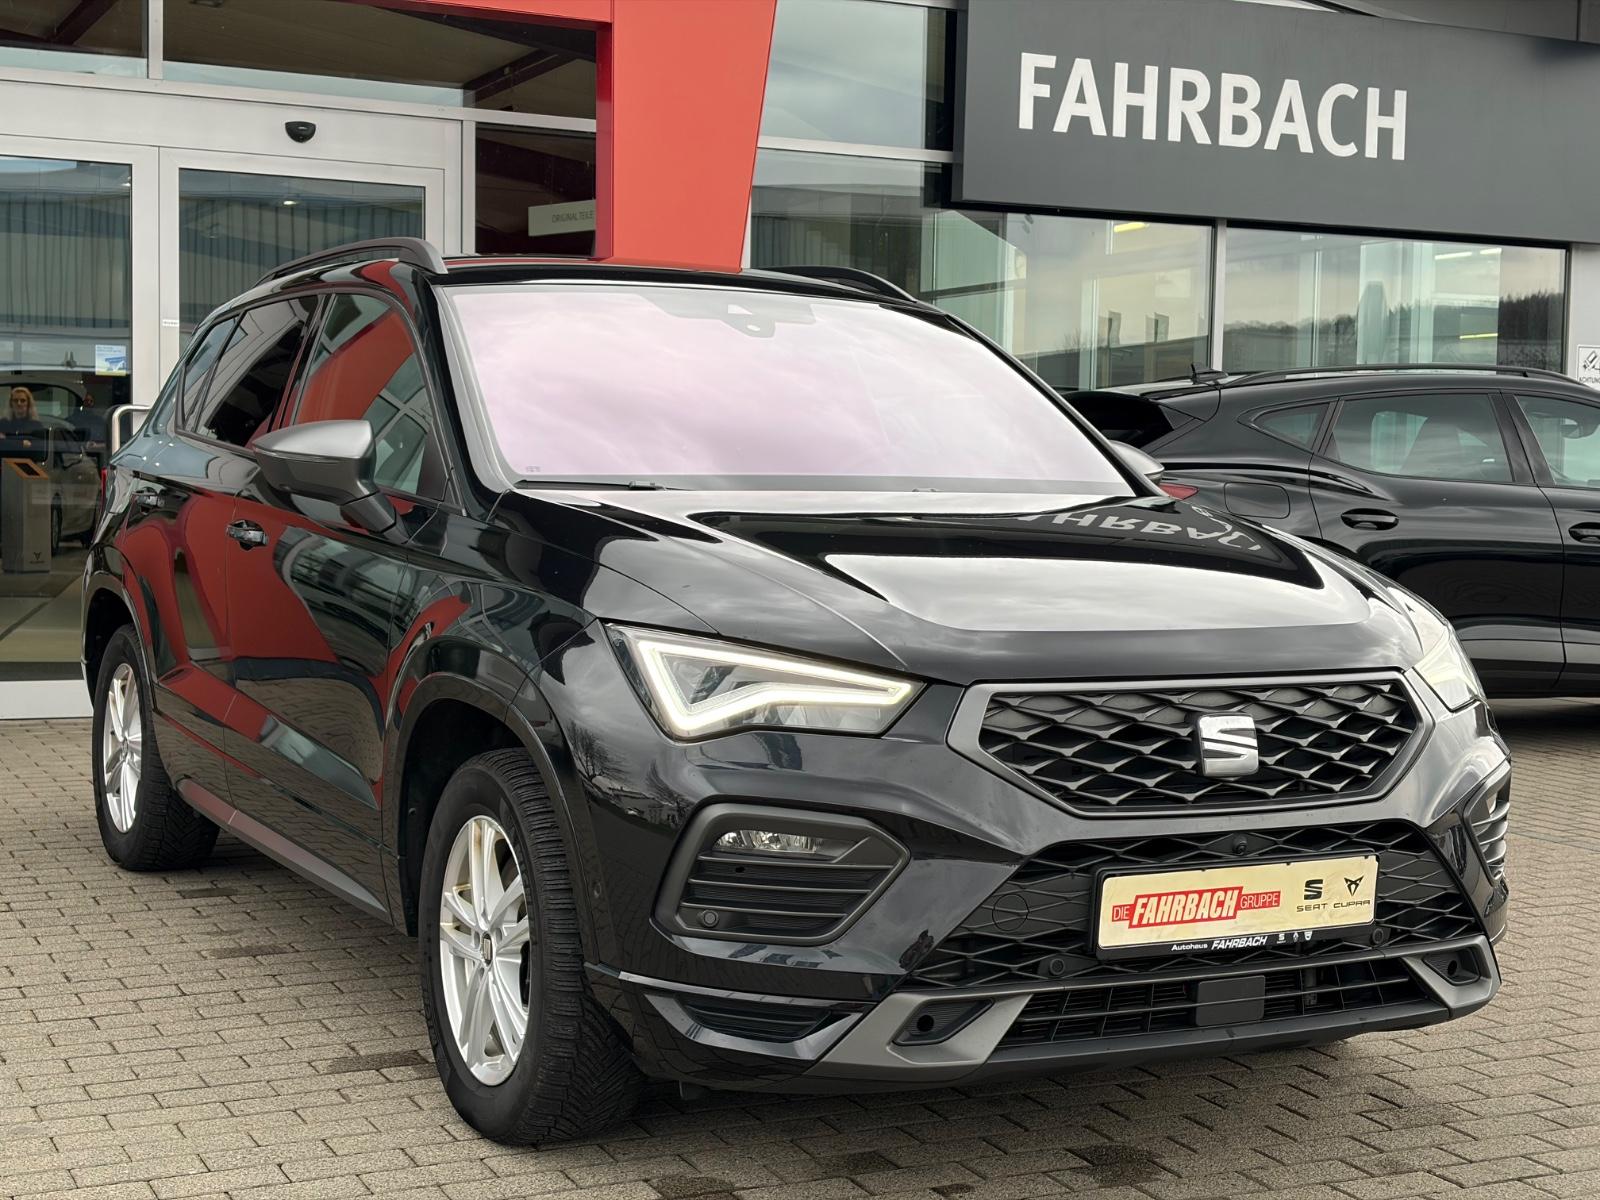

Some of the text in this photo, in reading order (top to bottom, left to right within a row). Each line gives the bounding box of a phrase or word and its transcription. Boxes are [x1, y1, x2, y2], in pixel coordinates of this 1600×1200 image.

[1018, 52, 1408, 161] FAHRBACH
[1113, 889, 1279, 926] DIE FAHRBACH GRUPPE
[1296, 900, 1370, 912] SEAT CUPRA
[1171, 936, 1267, 951] Autohaus FAHRBACH
